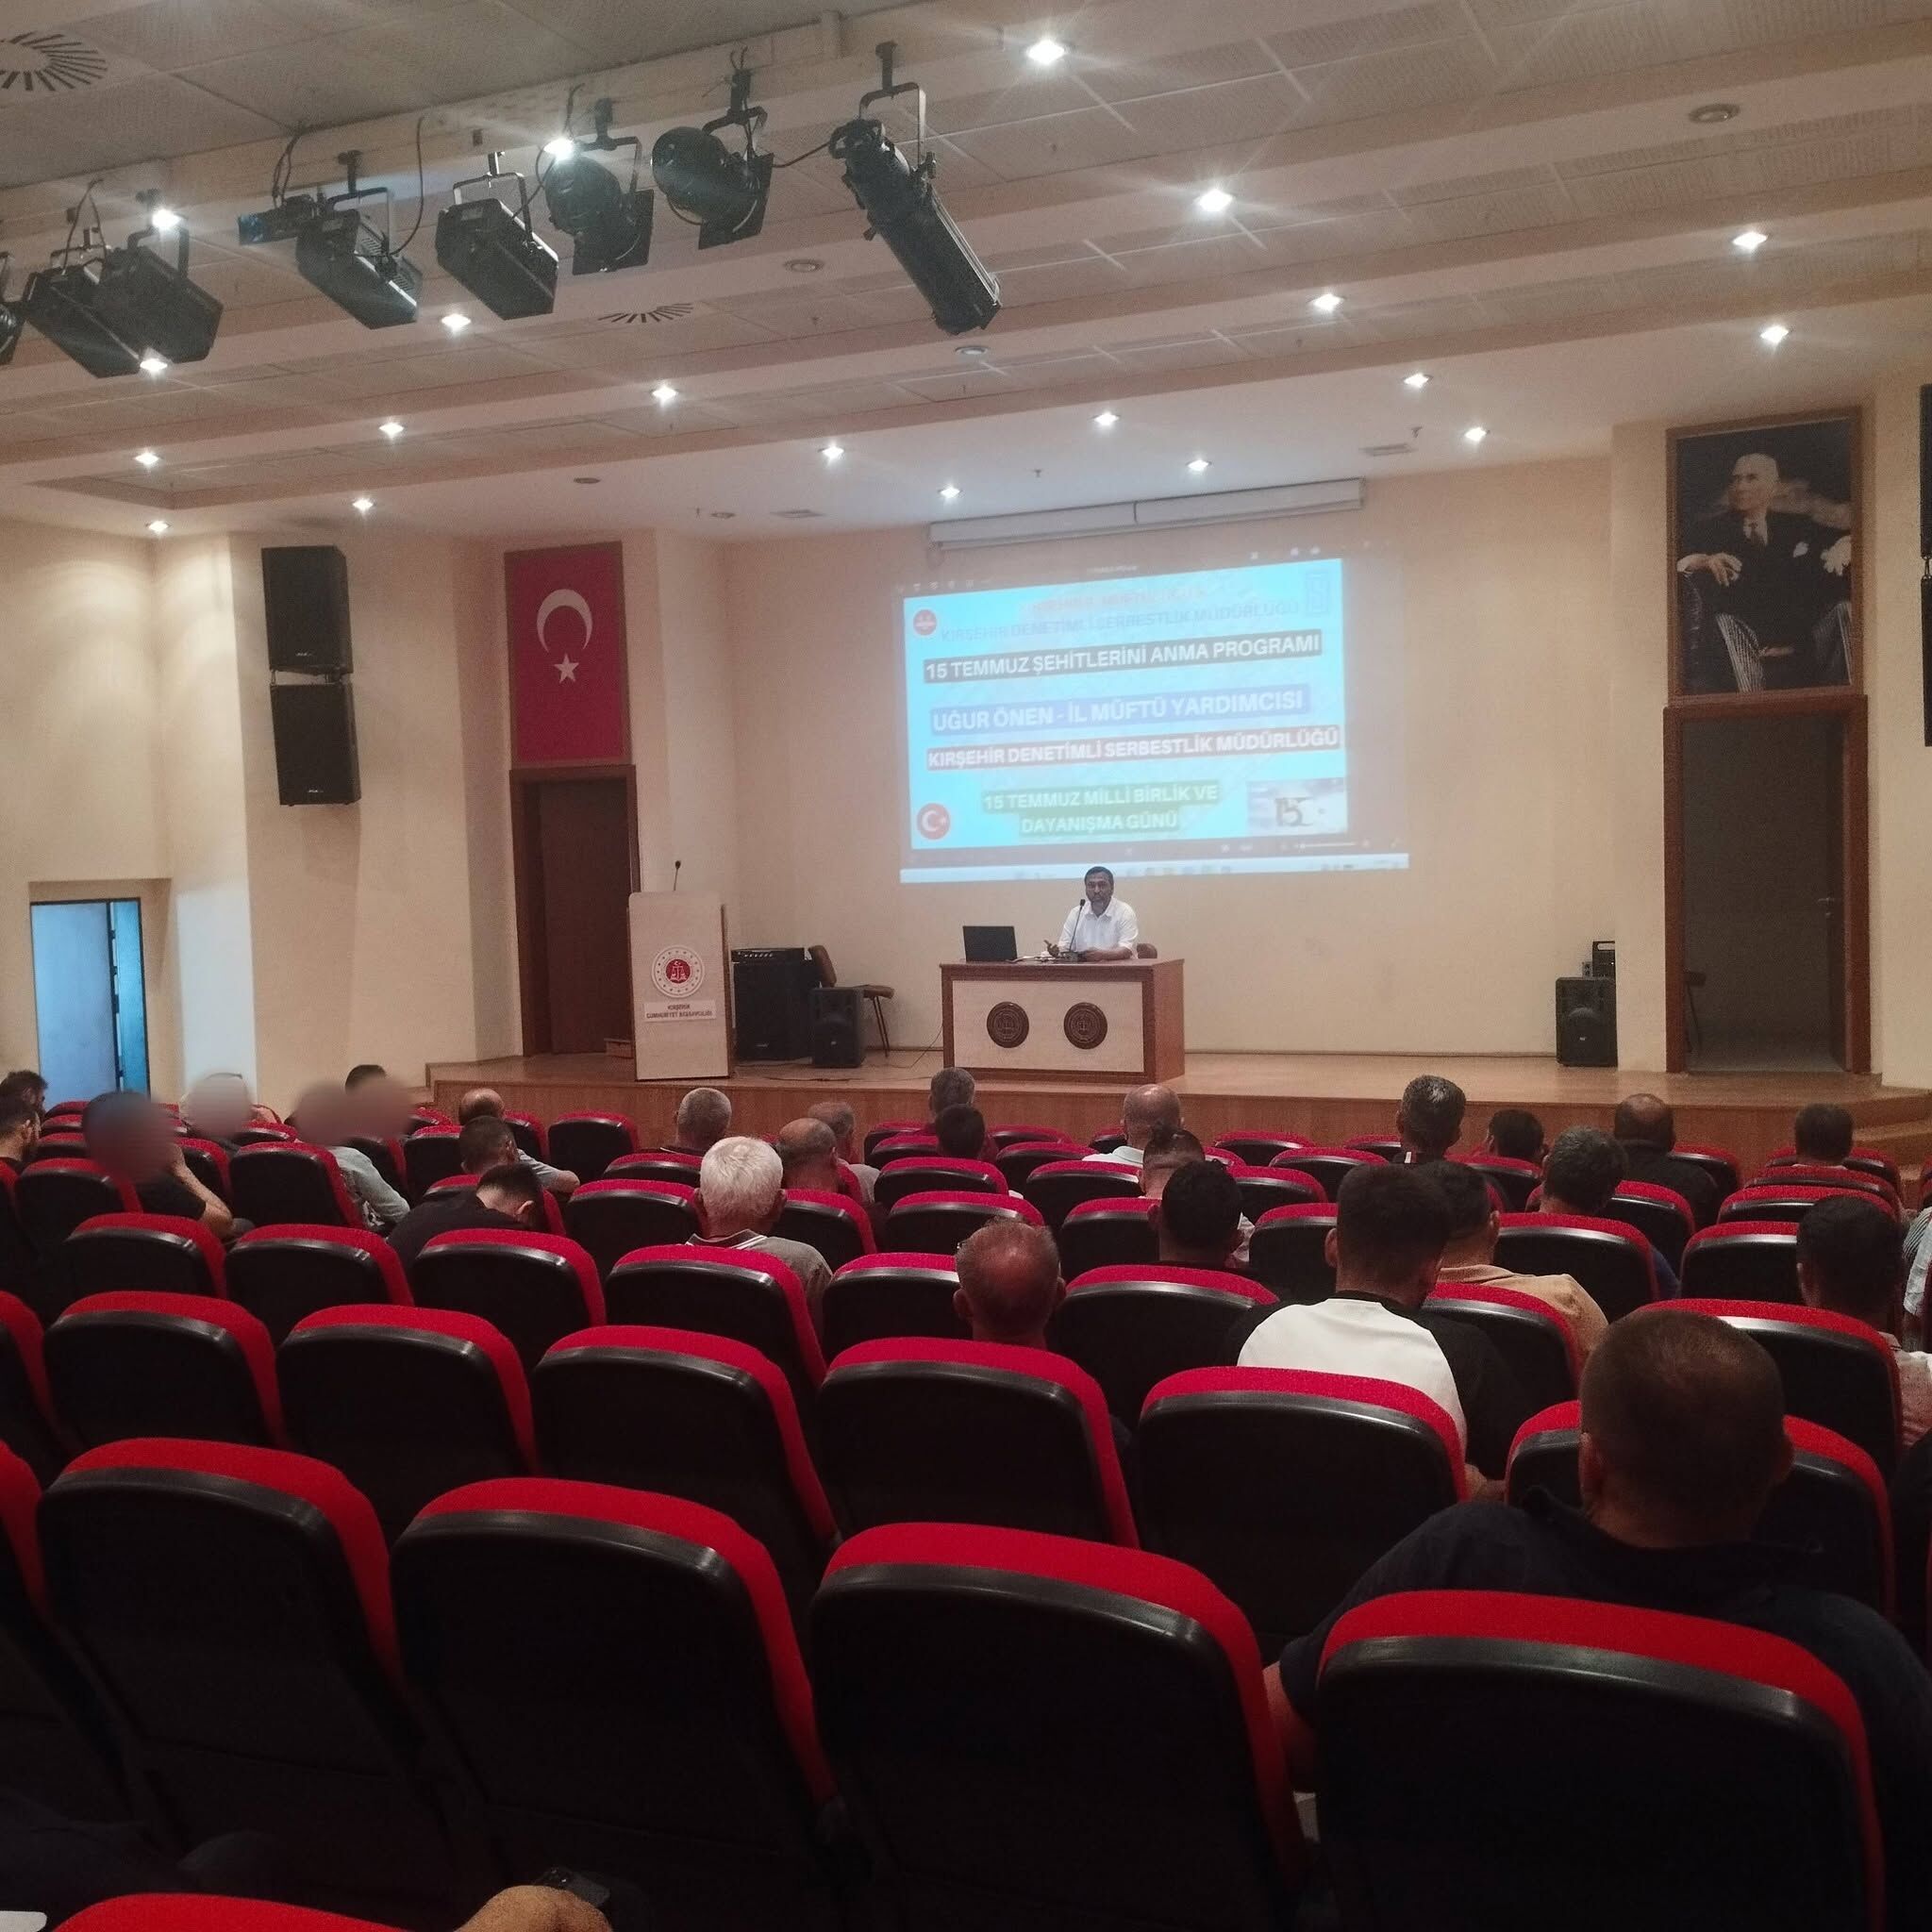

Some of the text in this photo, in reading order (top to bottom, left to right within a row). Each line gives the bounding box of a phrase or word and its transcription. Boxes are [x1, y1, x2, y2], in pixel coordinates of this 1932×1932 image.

[926, 634, 1320, 679] 15 TEMMUZ ŞEHİTLERİNİ ANMA PROGRAMI
[934, 708, 990, 732] UĞUR
[993, 705, 1053, 726] ÖNEN
[1068, 700, 1087, 723] İL
[1091, 696, 1166, 722] MÜFTÜ
[1171, 690, 1303, 716] YARDIMCISI
[928, 726, 1339, 769] KIRŞEHİR DENETİMLİ SERBESTLİK MÜDÜRLÜĞÜ
[985, 783, 1218, 810] 15 TEMMUZ MİLLİ BİRLİK VE
[1022, 810, 1178, 834] DAYANIŞMA GÜNÜ
